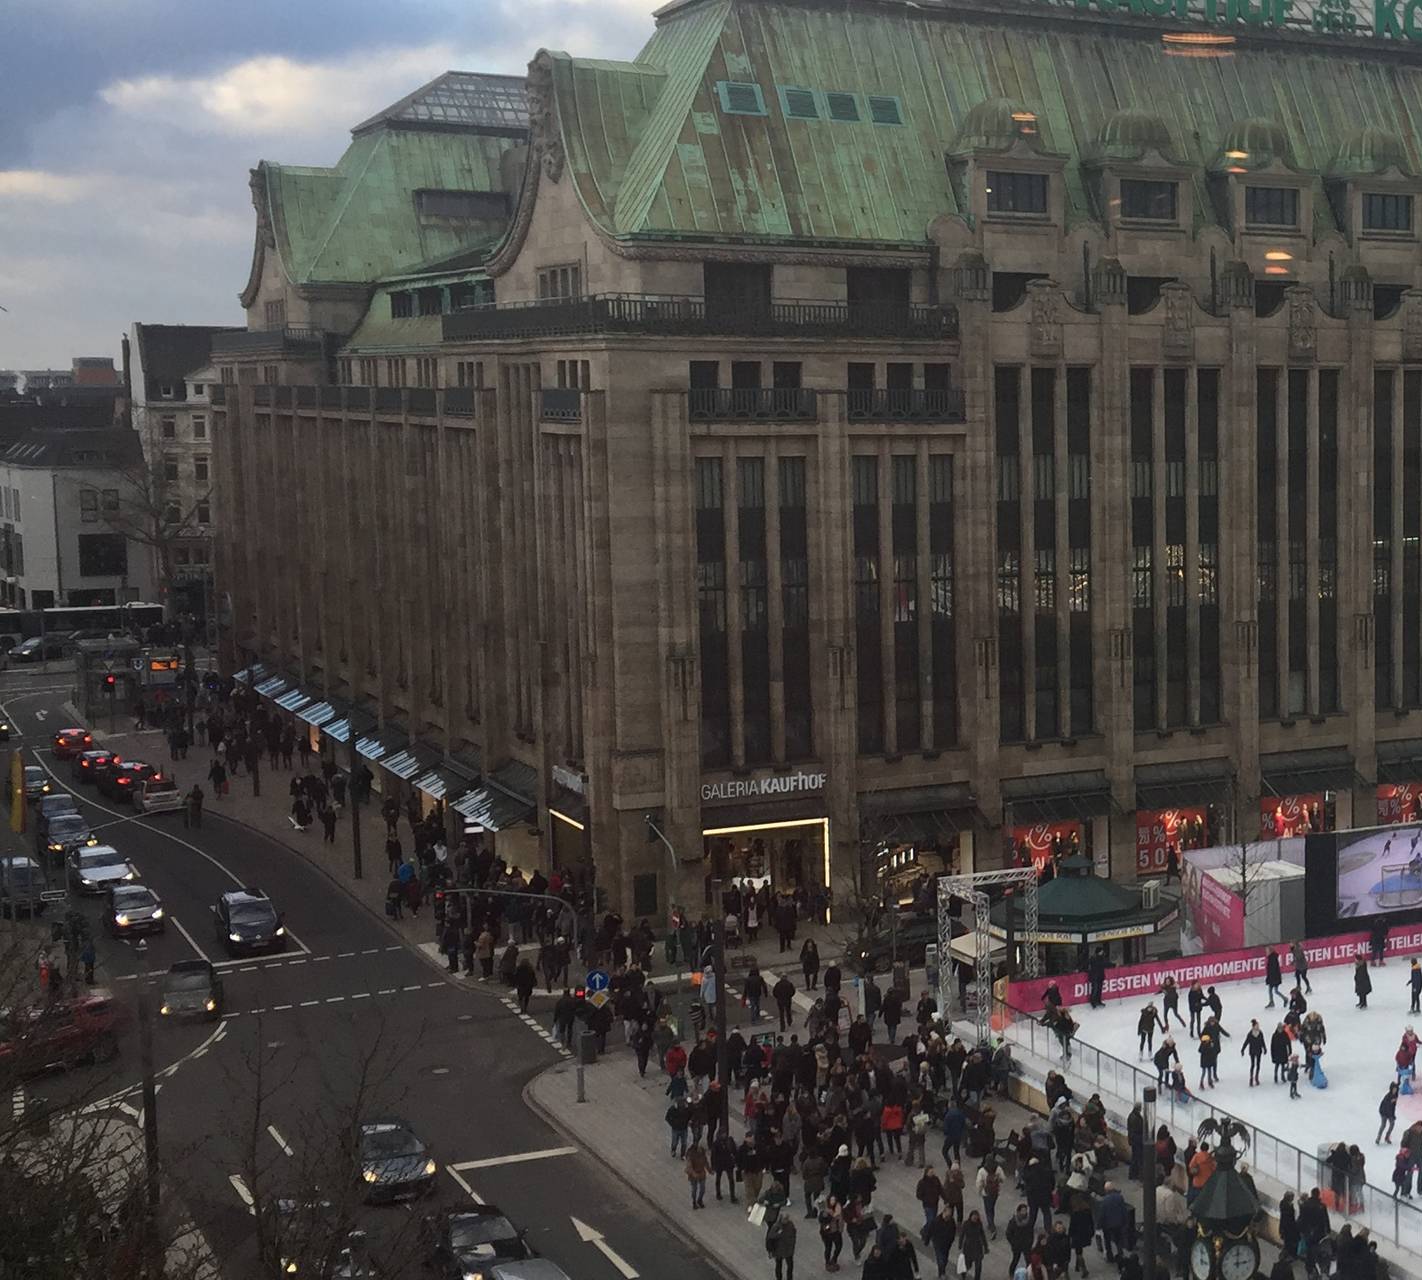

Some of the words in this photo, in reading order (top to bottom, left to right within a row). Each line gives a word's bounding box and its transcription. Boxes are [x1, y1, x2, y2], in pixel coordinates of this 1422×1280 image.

[701, 780, 759, 800] GALERIA
[1138, 847, 1165, 868] 50
[1102, 974, 1151, 993] BESTEN
[1153, 957, 1266, 986] WINTERMOMENTE
[1286, 947, 1332, 965] BSTEN
